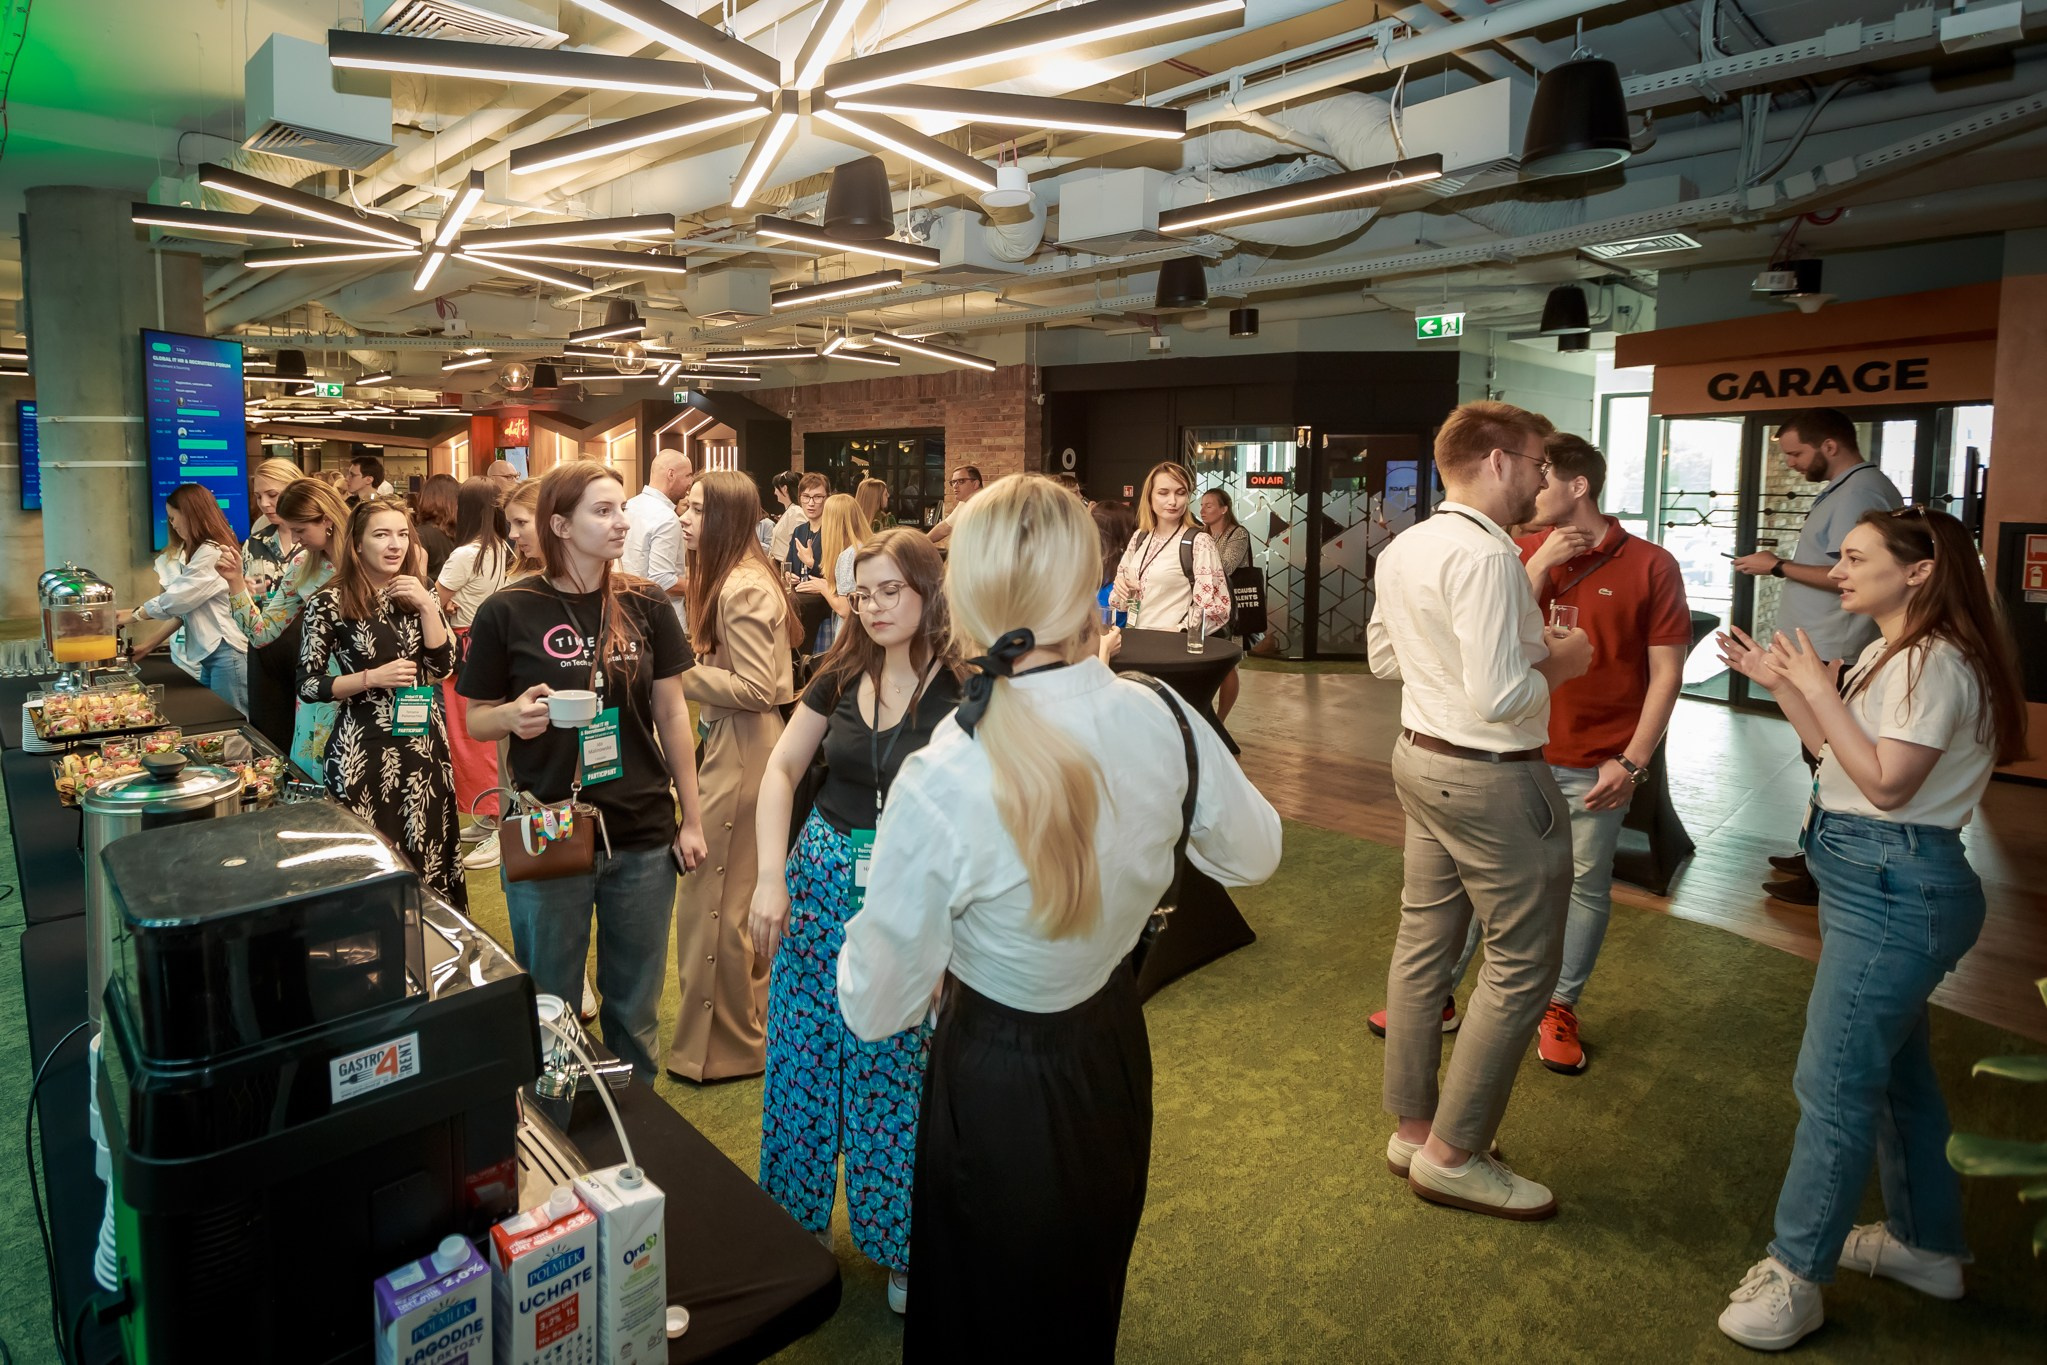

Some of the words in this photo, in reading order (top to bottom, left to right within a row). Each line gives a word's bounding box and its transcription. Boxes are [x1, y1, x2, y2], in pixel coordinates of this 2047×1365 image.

[1707, 357, 1929, 401] GARAGE
[1250, 476, 1266, 485] ON
[1266, 476, 1284, 485] AIR
[572, 659, 588, 667] Tech
[587, 768, 617, 781] PARTICIPANT
[338, 1050, 384, 1077] GASTRO
[375, 1045, 398, 1076] 4
[399, 1042, 413, 1073] RENT
[442, 1262, 484, 1288] 2,0%
[519, 1265, 592, 1314] UCHATE
